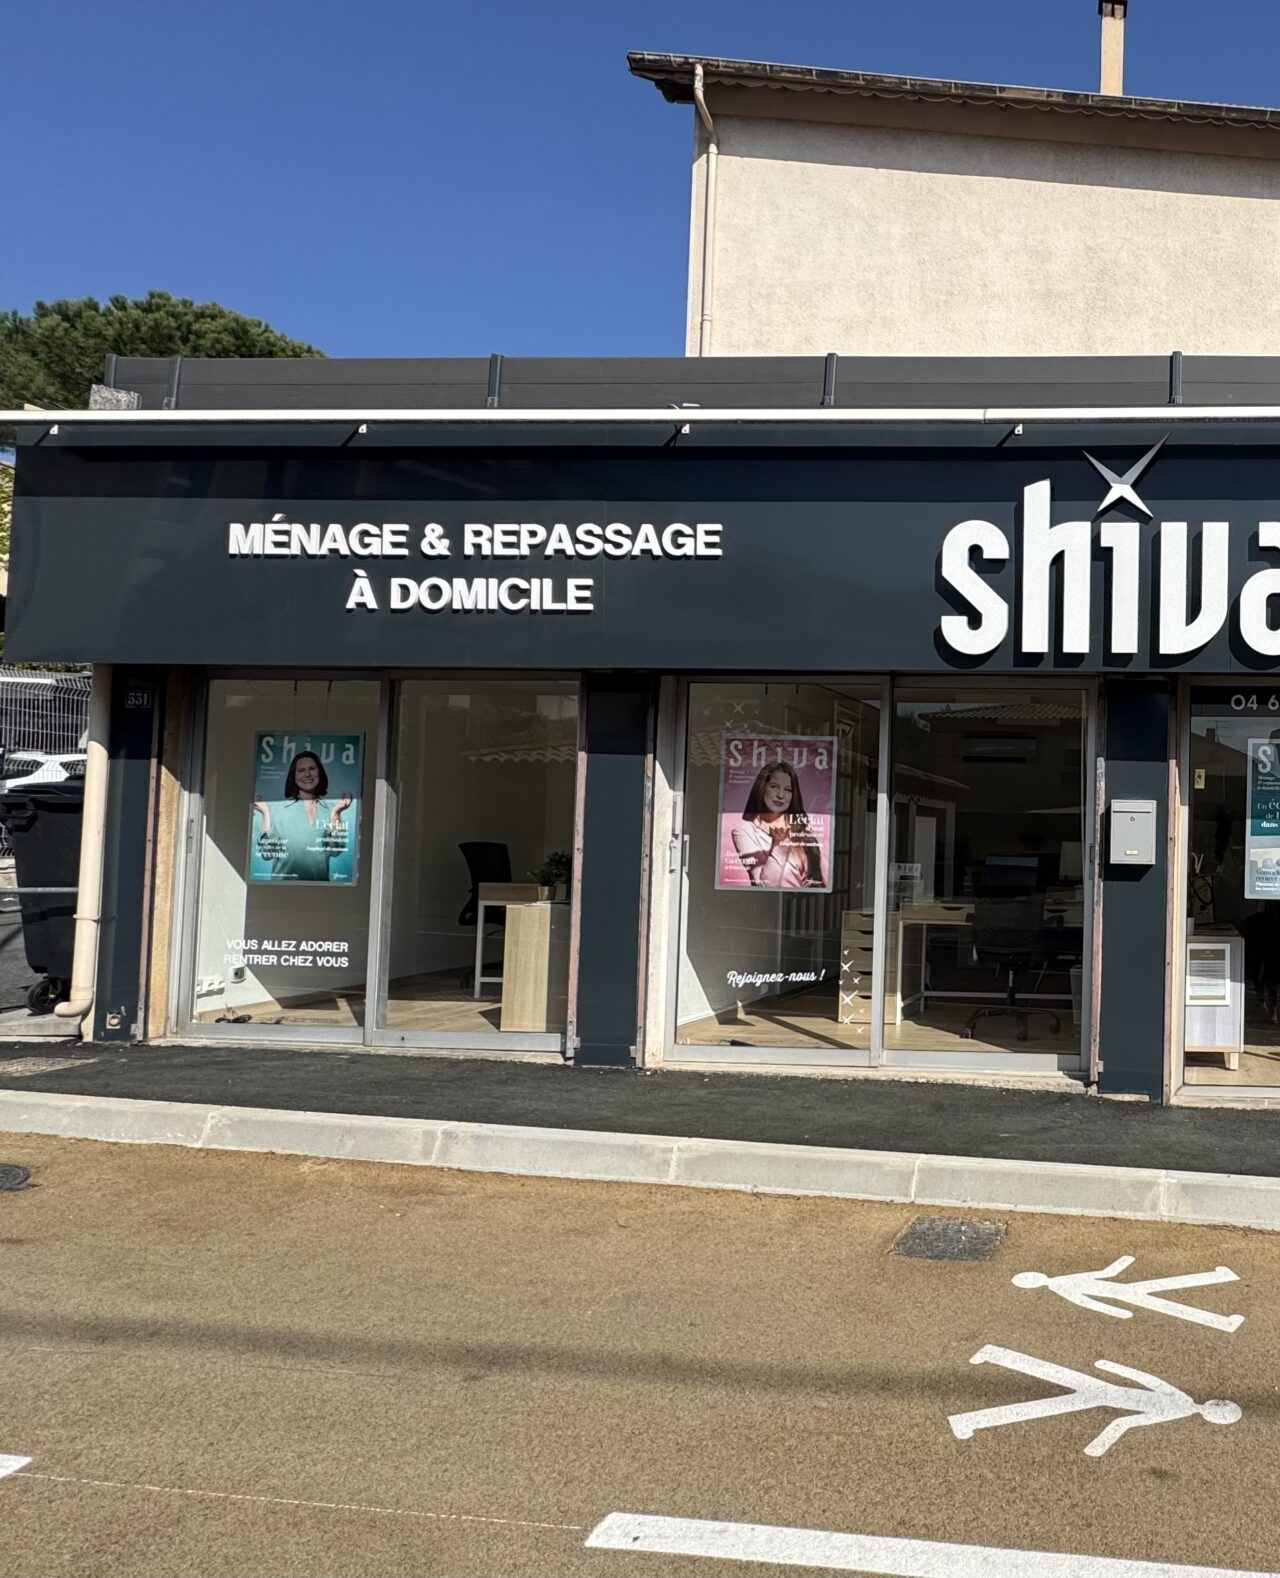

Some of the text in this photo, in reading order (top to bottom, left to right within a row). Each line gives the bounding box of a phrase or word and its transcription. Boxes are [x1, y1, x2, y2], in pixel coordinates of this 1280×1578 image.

[228, 513, 724, 557] MÉNAGE & REPASSAGE
[345, 569, 595, 612] À DOMICILE
[127, 692, 148, 705] 531
[1230, 694, 1258, 711] 04
[729, 740, 829, 770] Shiva
[1260, 820, 1279, 828] dans
[226, 939, 349, 953] VOUS ALLEZ ADORER
[223, 953, 349, 968] RENTRER CHEZ VOUS
[726, 970, 817, 988] Rejoignez-nous
